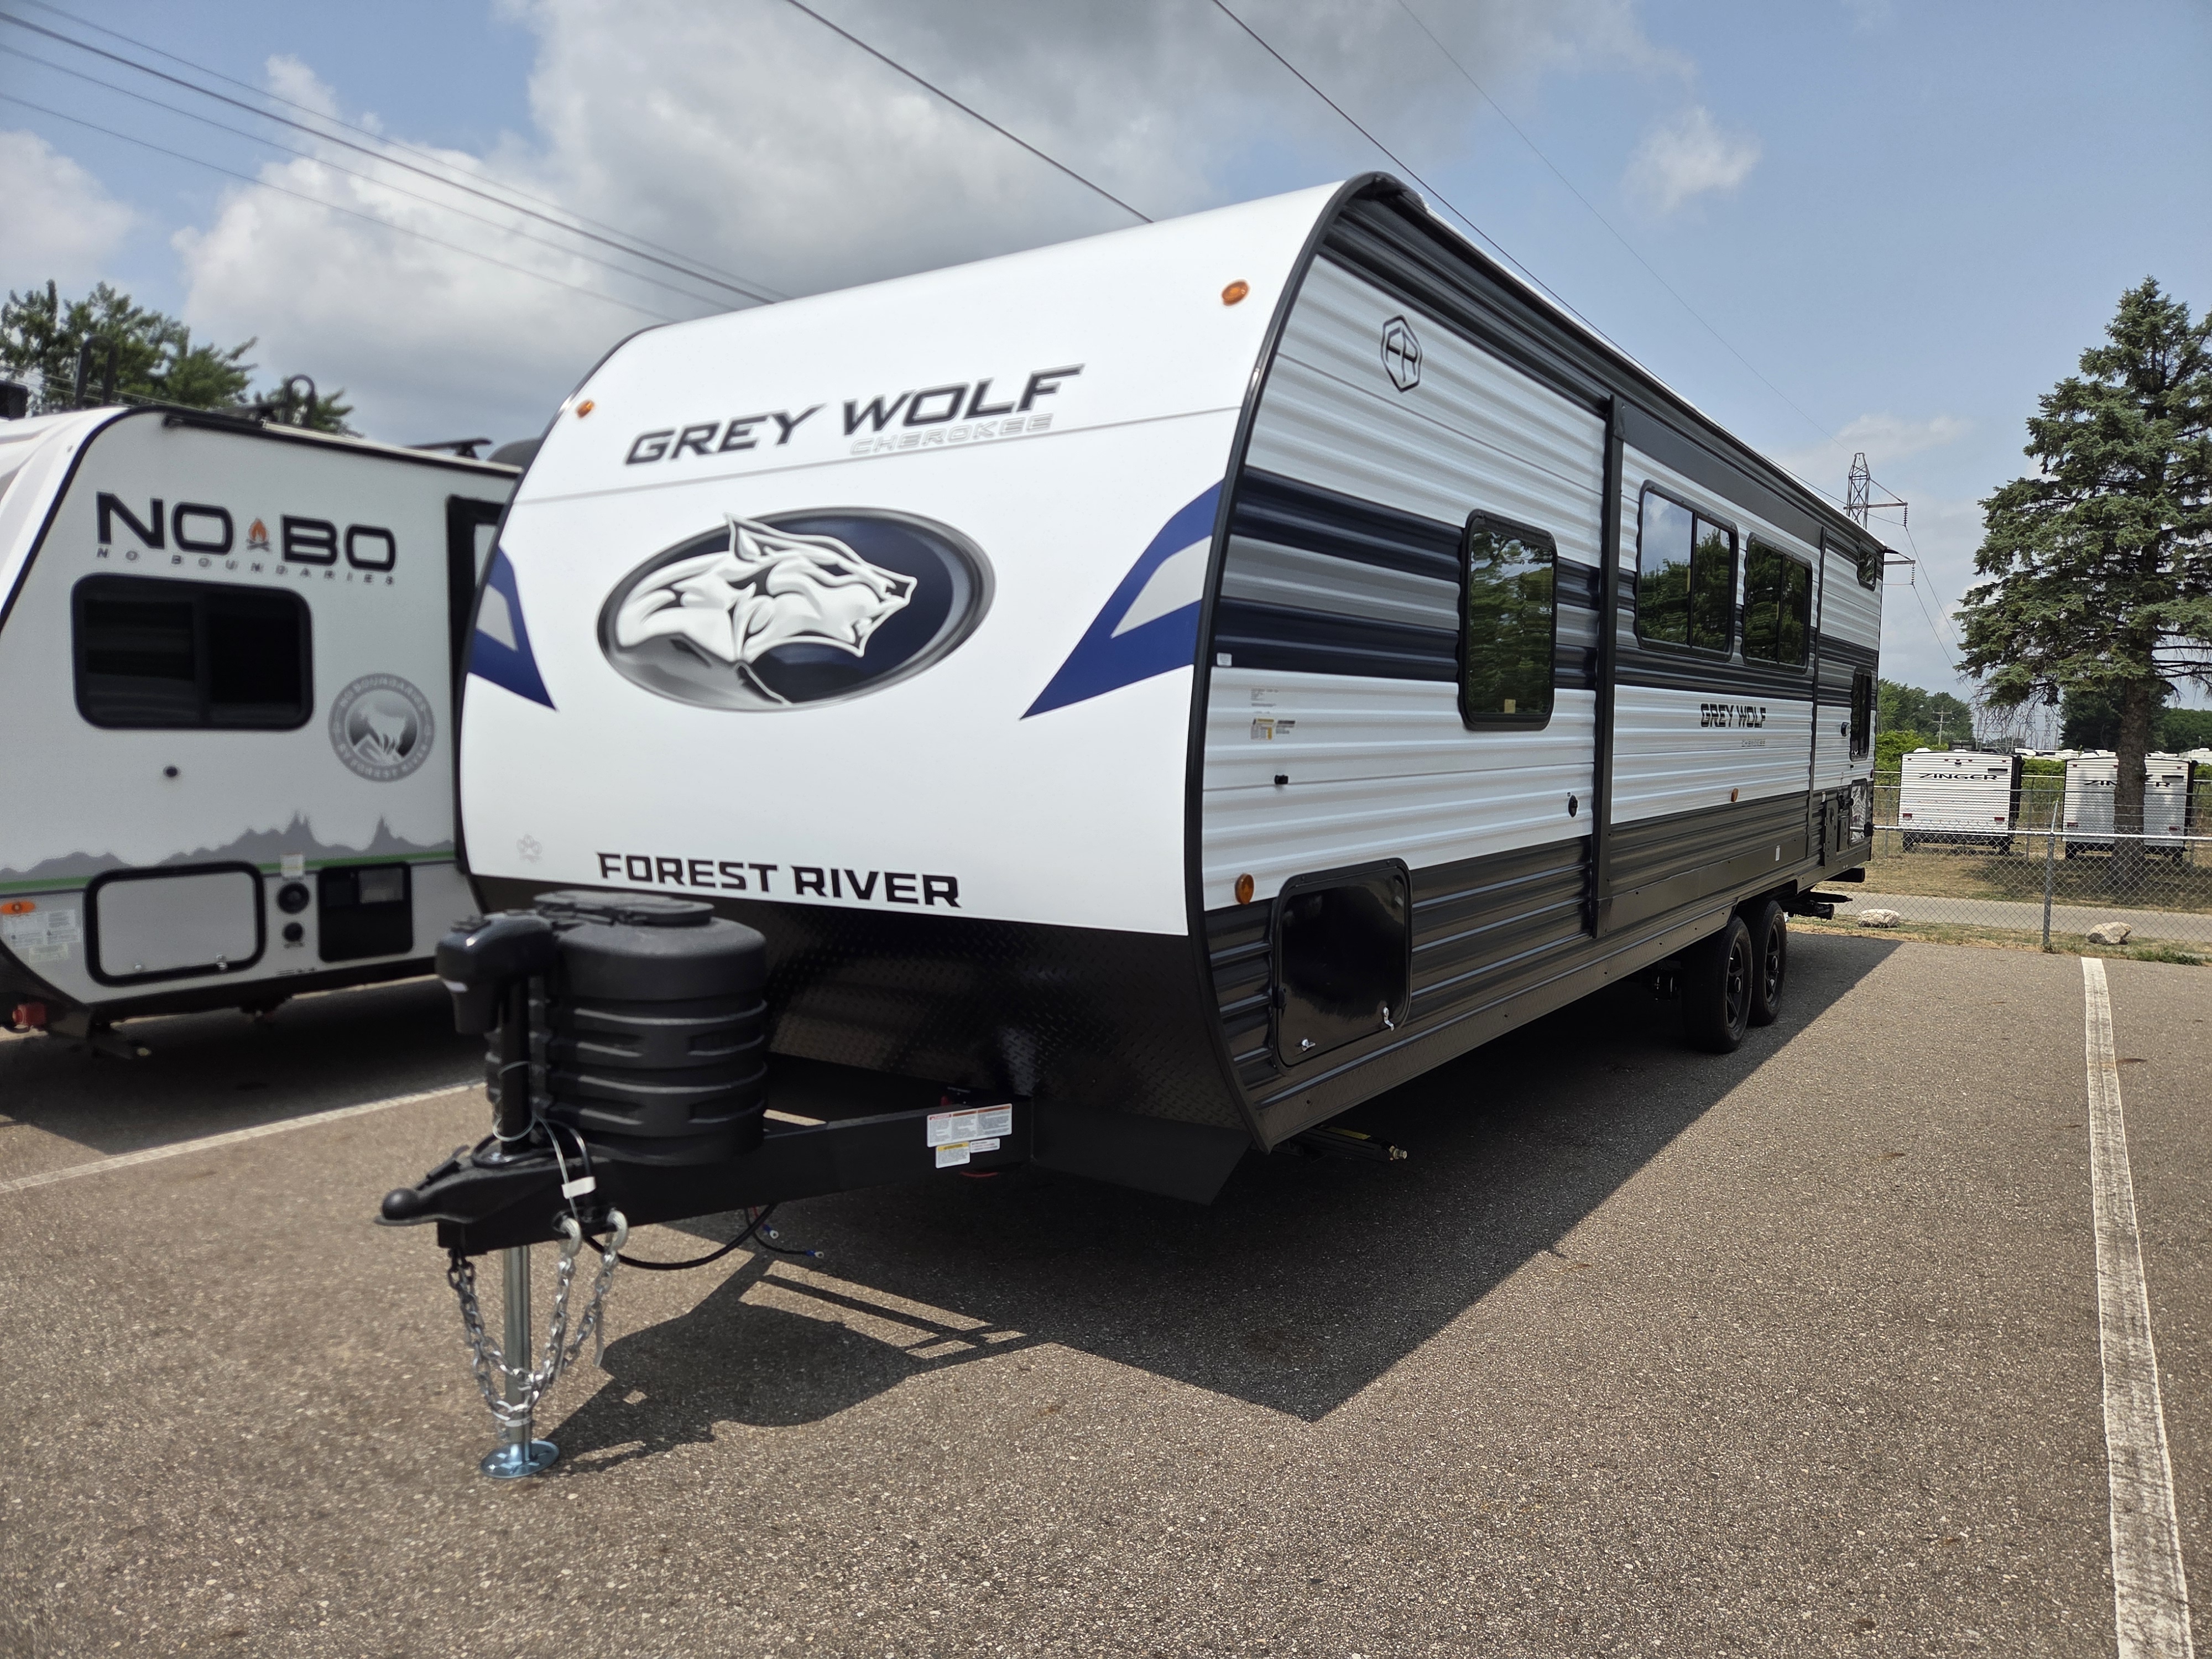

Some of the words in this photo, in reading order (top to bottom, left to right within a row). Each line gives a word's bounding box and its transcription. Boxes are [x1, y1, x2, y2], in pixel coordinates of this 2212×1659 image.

[624, 402, 828, 466] GREY
[842, 363, 1085, 436] WOLF
[850, 413, 1053, 456] CHEROKEE
[96, 547, 139, 562] NO
[171, 554, 394, 585] BOUNDARIES
[1700, 703, 1734, 728] GREY
[1736, 705, 1766, 728] WOLF
[2083, 779, 2171, 787] ZINR
[596, 852, 778, 893] FOREST
[790, 864, 962, 909] RIVER
